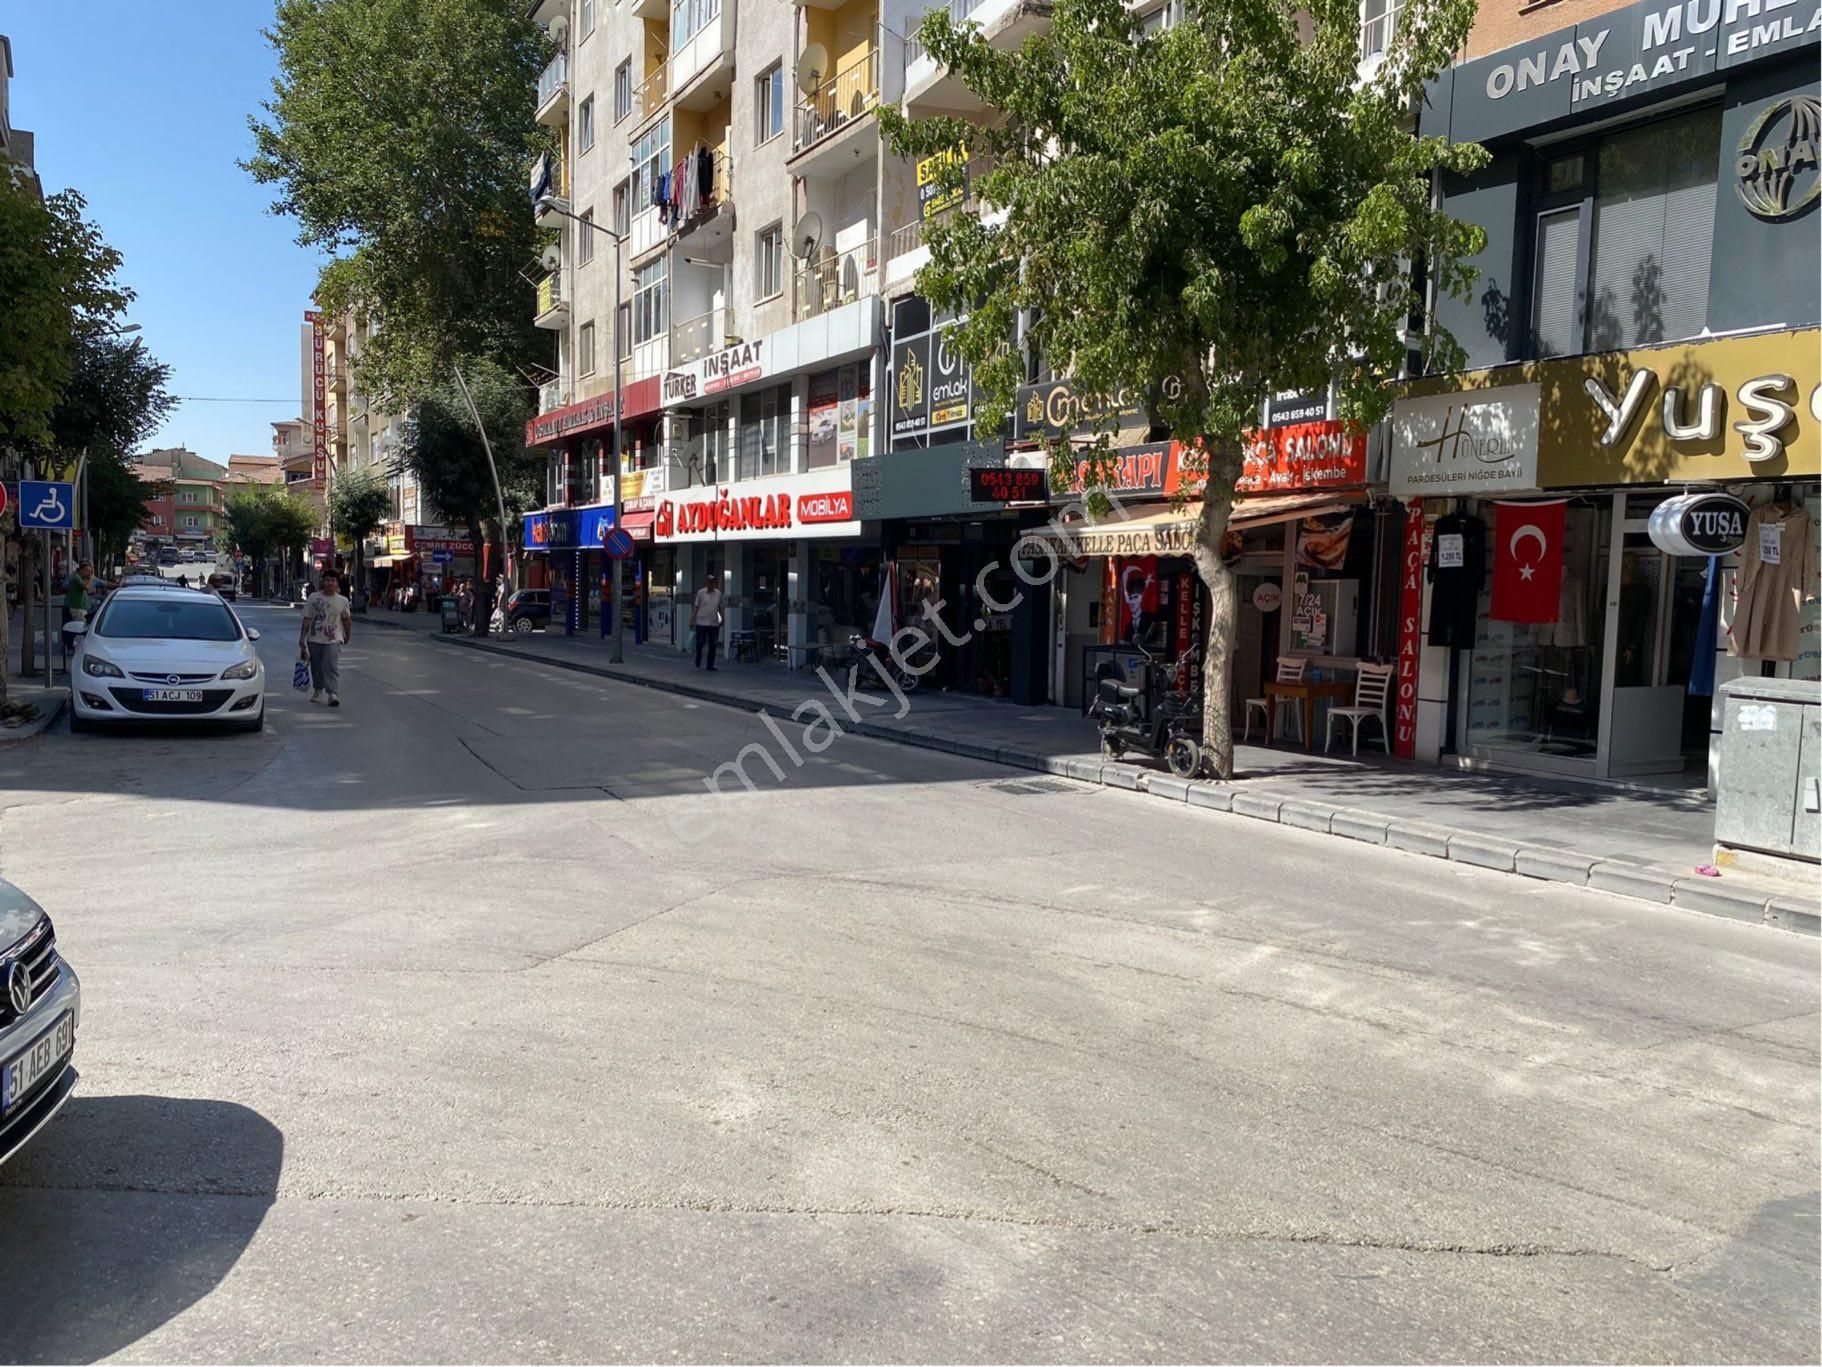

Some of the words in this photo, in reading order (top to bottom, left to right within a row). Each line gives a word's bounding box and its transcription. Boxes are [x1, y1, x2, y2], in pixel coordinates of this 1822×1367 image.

[1486, 29, 1611, 100] ONAY
[1572, 46, 1695, 103] İNŞAAT
[315, 408, 325, 470] KURSU
[1271, 411, 1289, 423] 0543
[1305, 407, 1315, 418] 40
[1315, 405, 1325, 416] 51
[677, 488, 793, 534] AYDOĞANLAR
[800, 495, 848, 517] MOBİLYA
[1117, 532, 1151, 554] PAÇA
[1404, 507, 1421, 590] PAÇA
[1181, 578, 1190, 638] KELLE
[1299, 593, 1321, 606] 7/24
[149, 690, 159, 700] 51
[162, 690, 180, 700] ACJ
[187, 691, 202, 700] 109
[1398, 616, 1415, 742] SALONU
[9, 1059, 24, 1099] 51
[28, 1037, 50, 1084] AEB
[55, 1017, 72, 1056] 691
